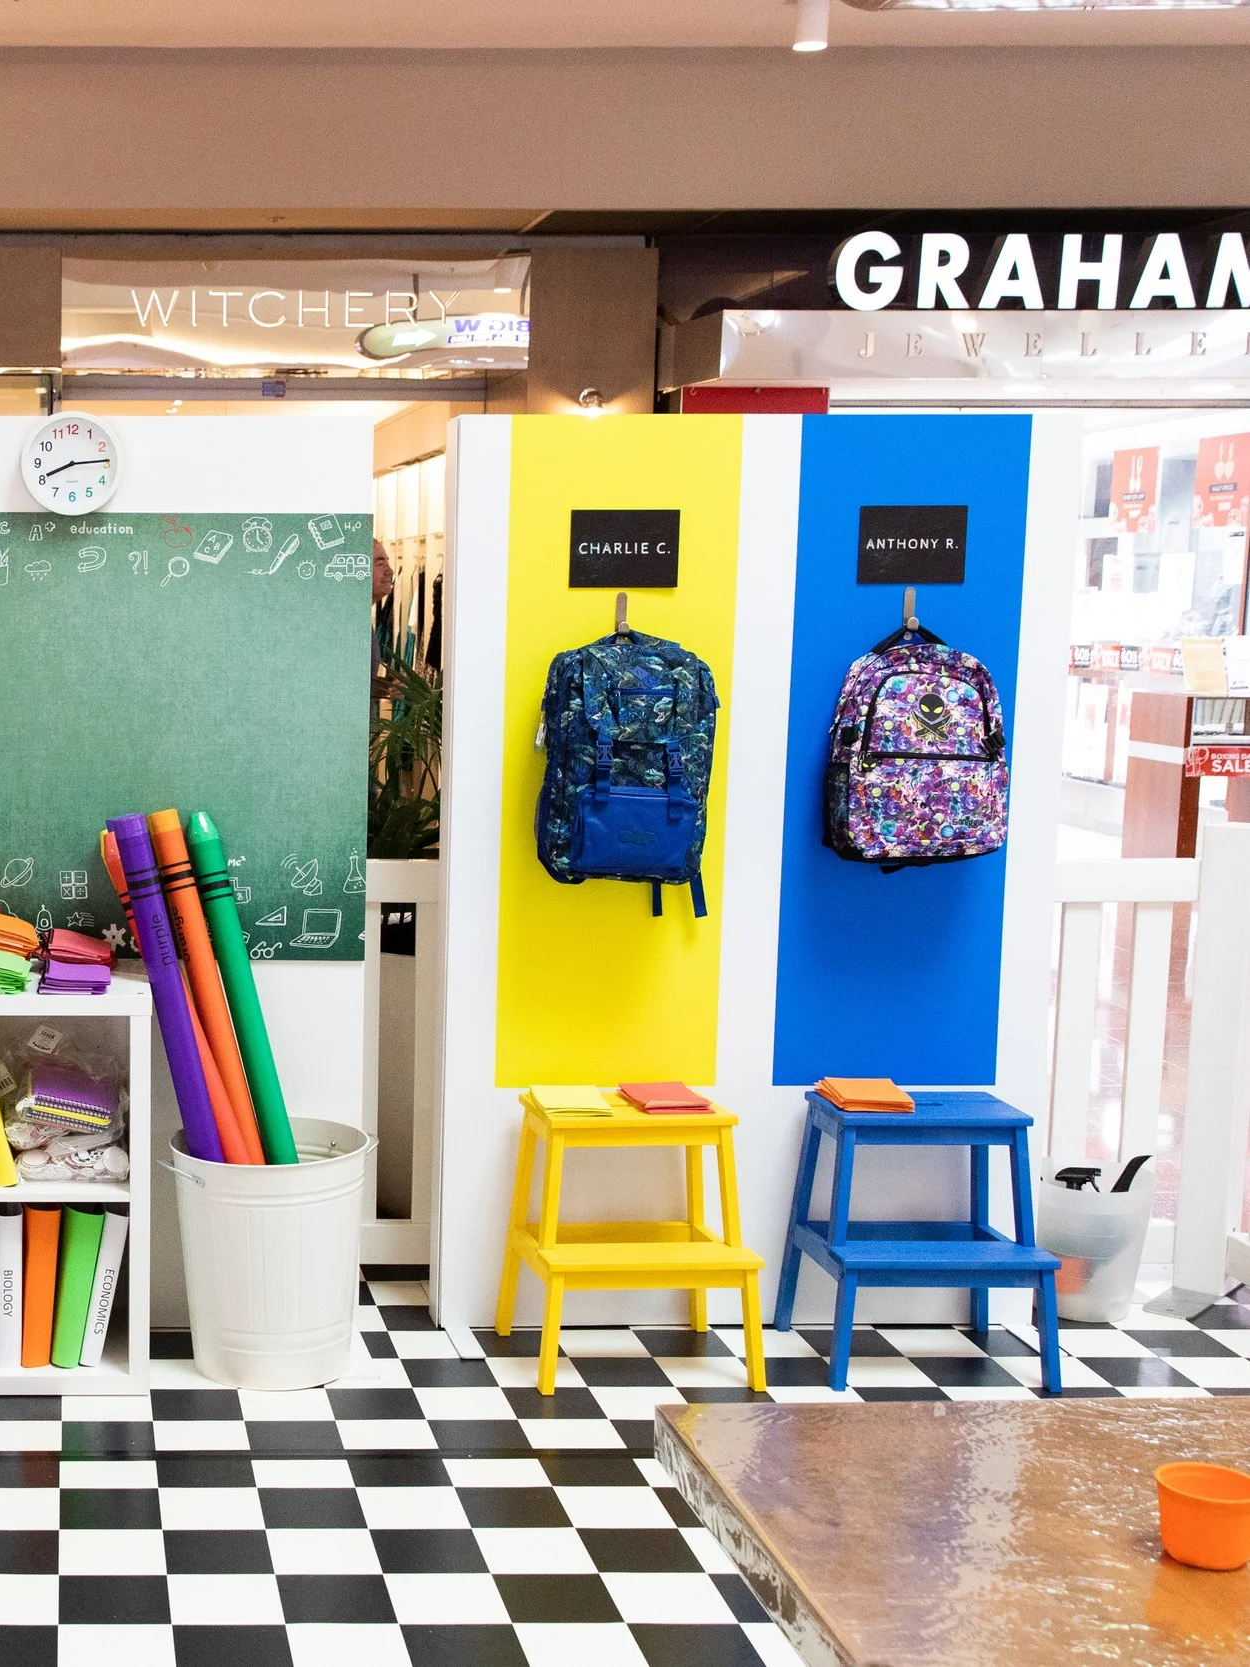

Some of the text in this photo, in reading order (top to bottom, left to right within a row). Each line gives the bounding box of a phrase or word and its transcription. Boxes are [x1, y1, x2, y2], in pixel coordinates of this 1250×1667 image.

[131, 289, 460, 328] WITCHERY
[52, 428, 64, 439] 11
[66, 424, 79, 435] 12
[87, 428, 92, 440] 1
[39, 441, 53, 452] 10
[98, 441, 106, 452] 2
[34, 457, 42, 469] 9
[38, 474, 46, 486] 8
[98, 475, 106, 486] 4
[51, 487, 59, 498] 7
[68, 491, 76, 502] 6
[85, 487, 93, 498] 5
[70, 522, 134, 535] education
[578, 542, 671, 555] CHARLIE C.
[866, 538, 959, 550] ANTHONY R.
[1211, 760, 1250, 773] SALE
[151, 913, 176, 967] purple
[3, 1269, 14, 1318] BIOLOGY
[93, 1268, 116, 1336] ECONOMICS
